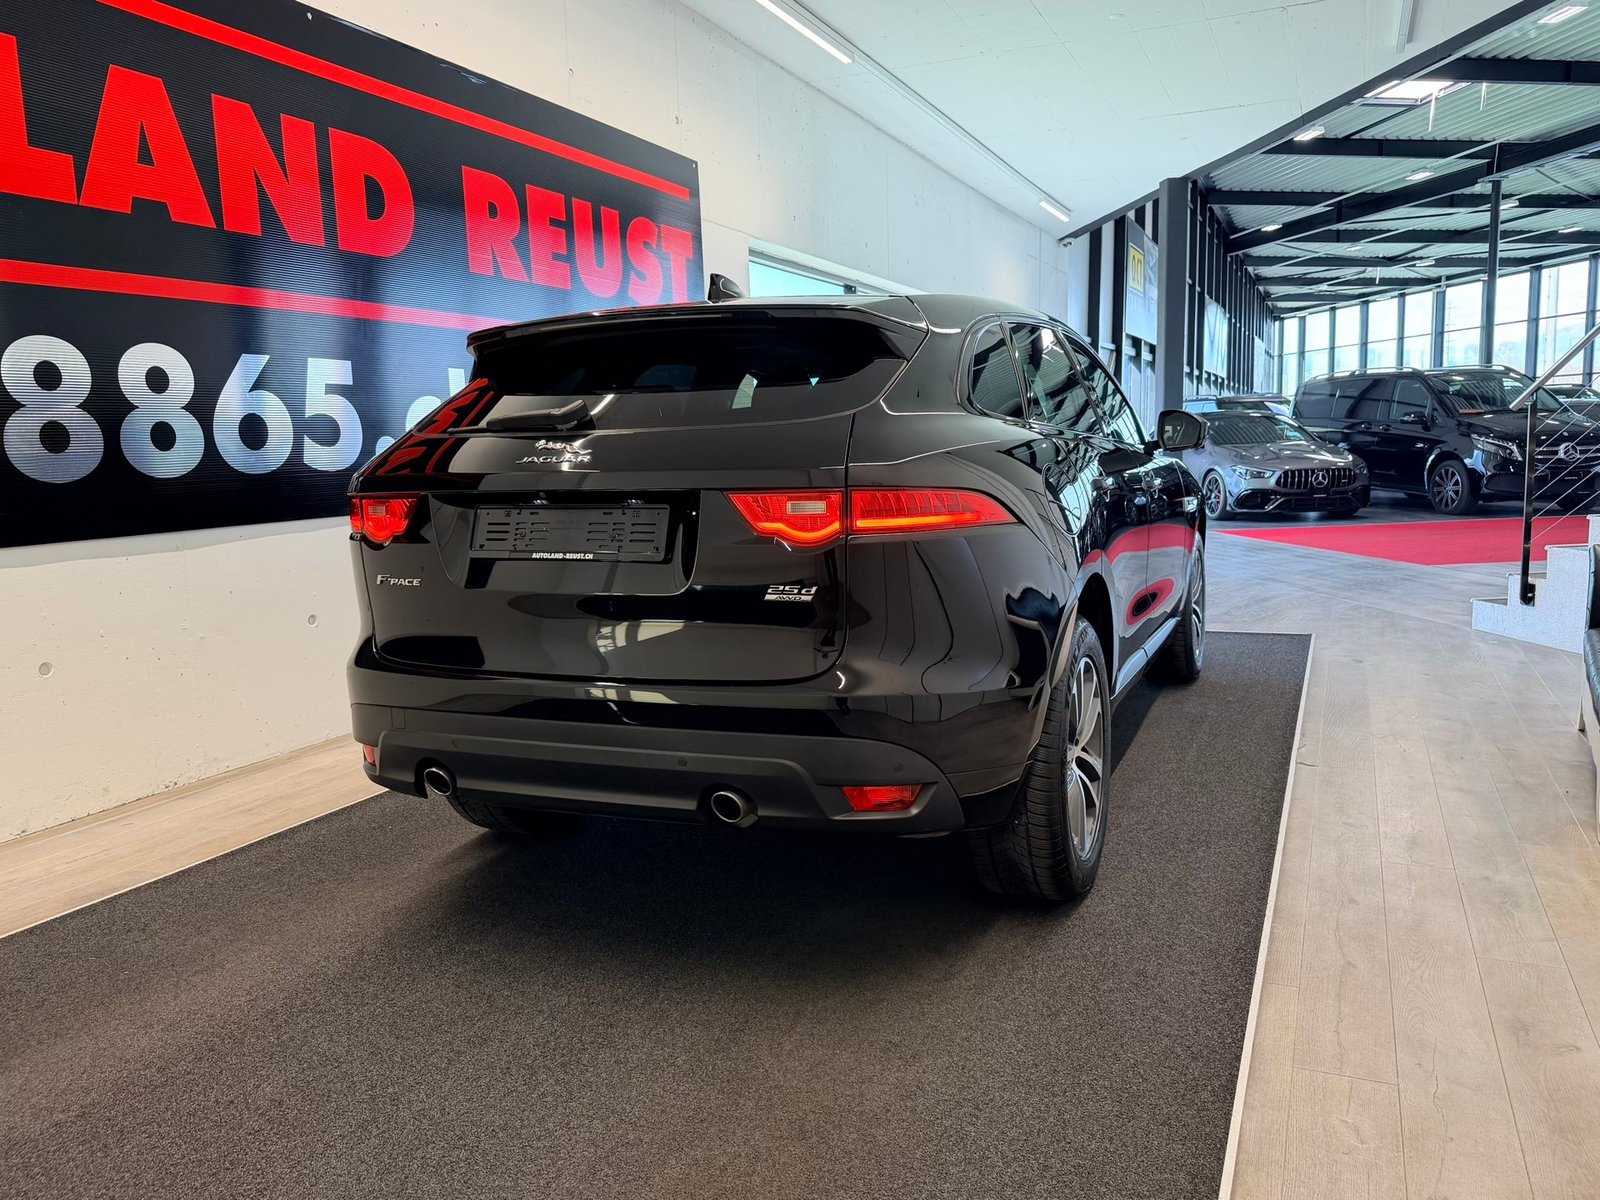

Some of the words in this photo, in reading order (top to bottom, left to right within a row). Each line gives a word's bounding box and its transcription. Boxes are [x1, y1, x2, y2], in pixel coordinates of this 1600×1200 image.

[461, 165, 695, 306] REUST
[515, 455, 592, 464] JAGUAR
[531, 552, 594, 560] AUTOLAND-REUST.CH
